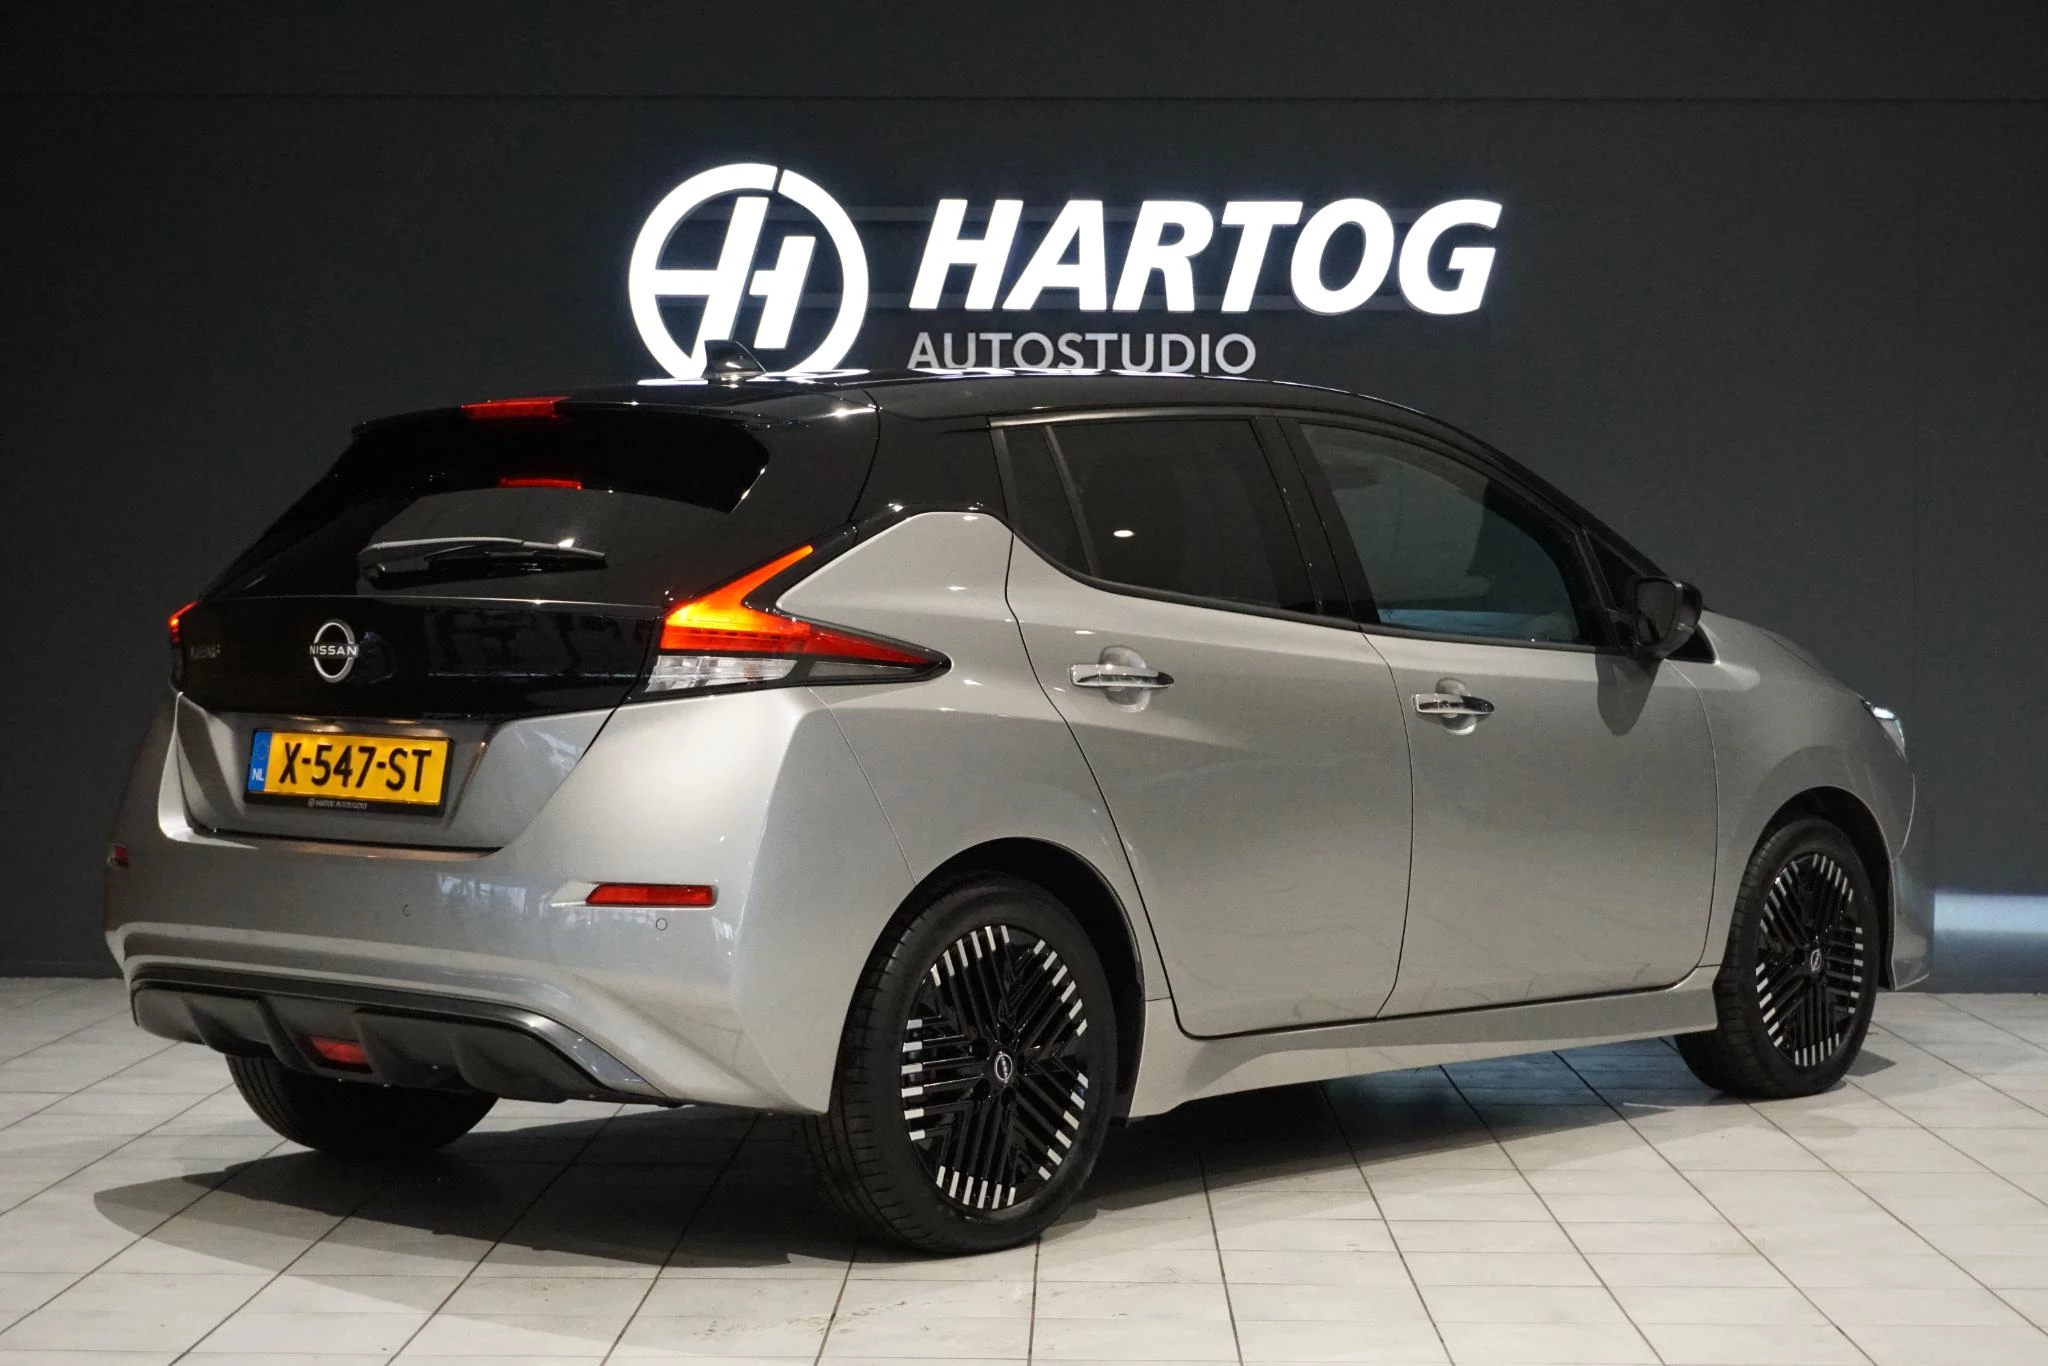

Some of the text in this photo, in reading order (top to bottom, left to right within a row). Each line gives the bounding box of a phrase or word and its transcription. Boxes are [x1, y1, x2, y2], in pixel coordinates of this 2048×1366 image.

[908, 197, 1503, 315] HARTOG
[906, 331, 1257, 374] AUTOSTUDIO
[309, 644, 359, 657] NISSAN
[251, 767, 265, 782] NL
[278, 741, 432, 793] X-547-ST
